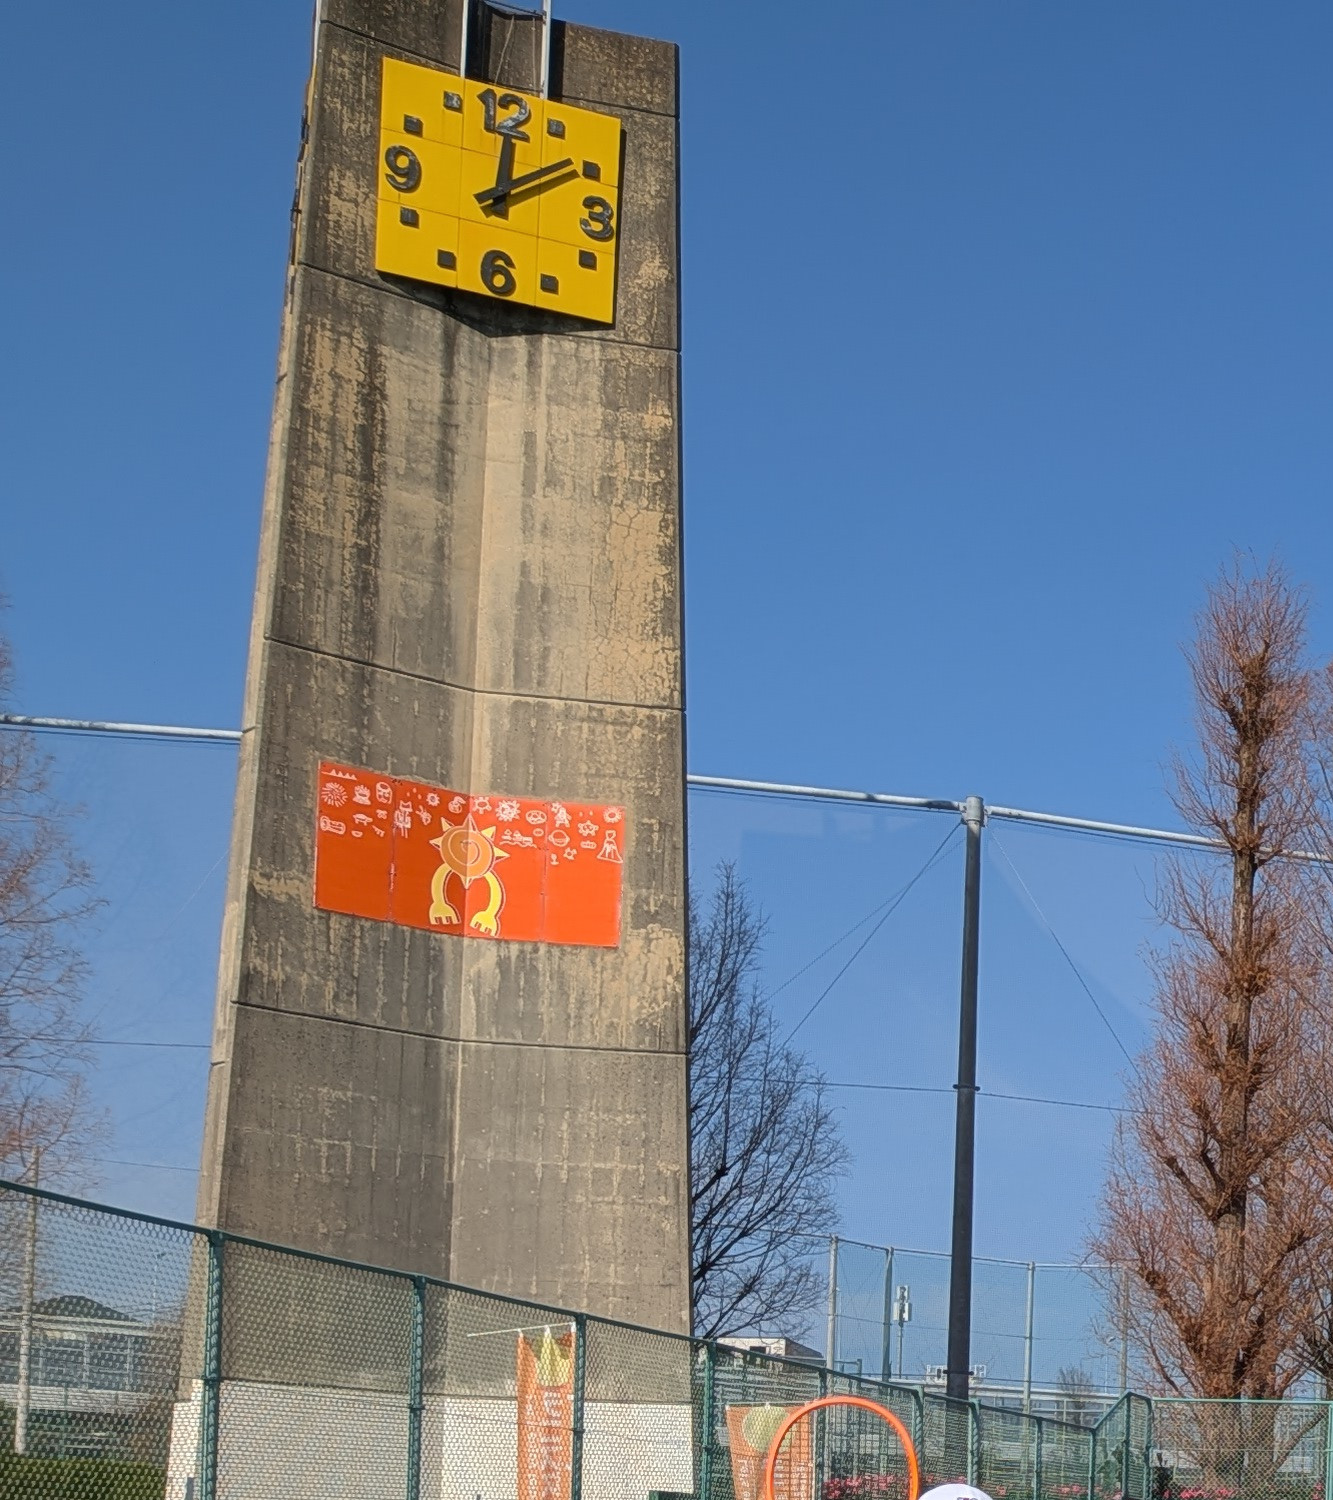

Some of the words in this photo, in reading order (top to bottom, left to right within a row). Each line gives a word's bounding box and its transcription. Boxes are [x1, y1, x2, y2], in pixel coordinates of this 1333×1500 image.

[477, 88, 531, 143] 12
[385, 145, 422, 193] 9
[580, 195, 615, 242] 3
[480, 250, 517, 297] 6
